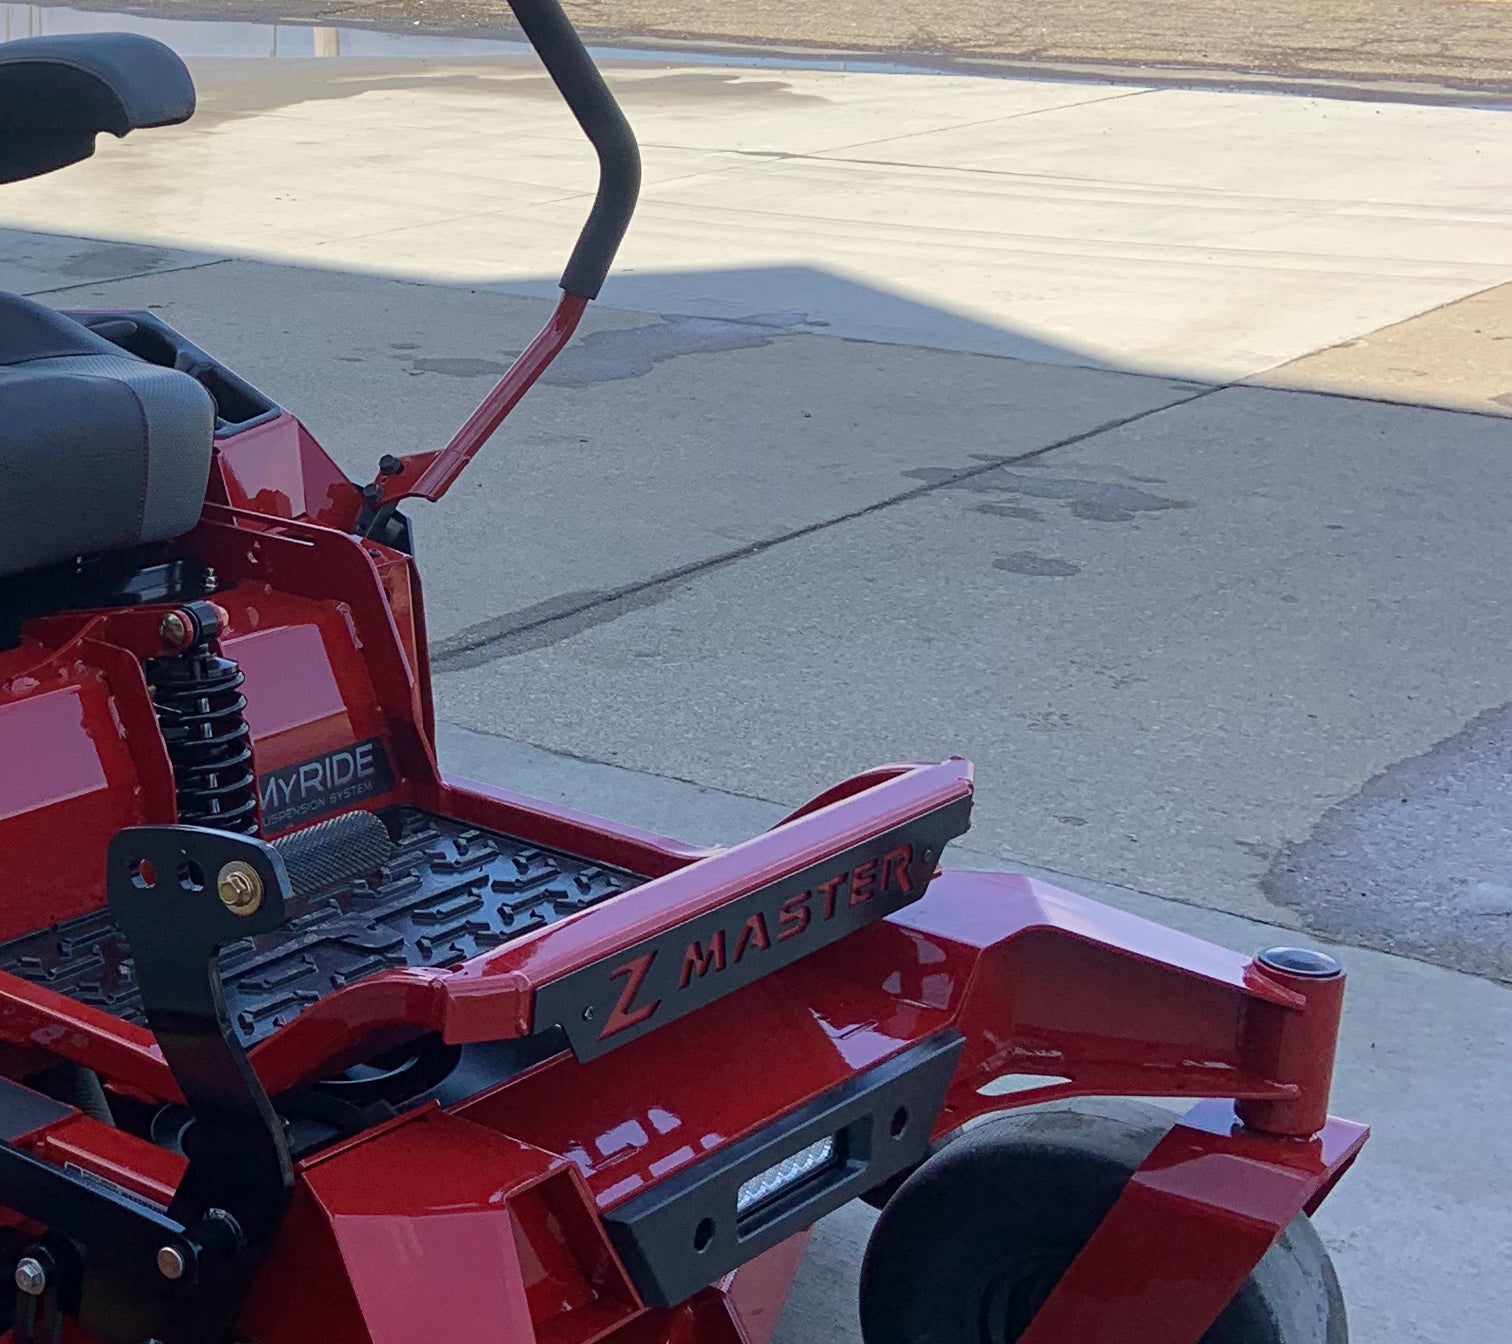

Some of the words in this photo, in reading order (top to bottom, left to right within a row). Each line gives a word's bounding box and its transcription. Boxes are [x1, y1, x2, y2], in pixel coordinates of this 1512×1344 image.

[262, 796, 326, 828] USPENSION
[328, 780, 373, 805] SYSTEM
[598, 950, 663, 1041] Z
[678, 843, 914, 990] MASTER
